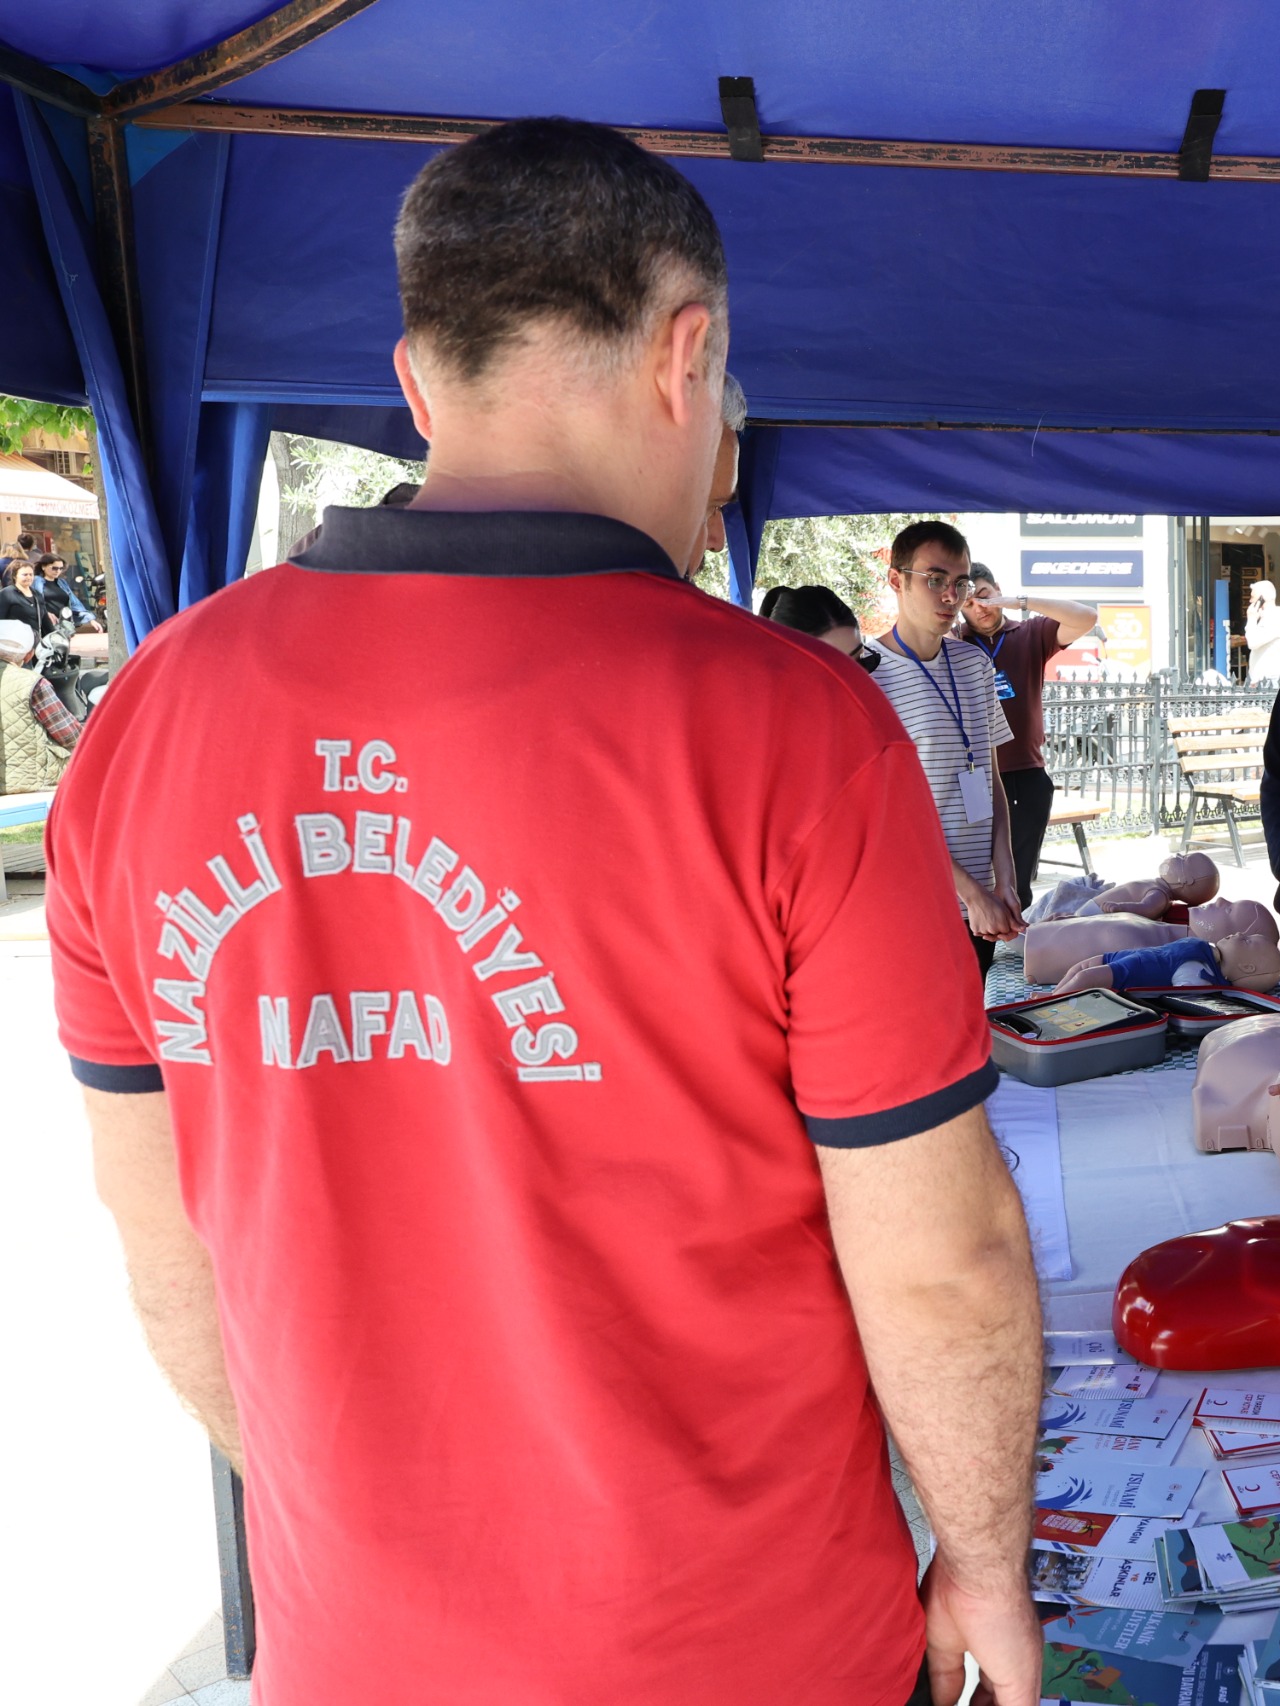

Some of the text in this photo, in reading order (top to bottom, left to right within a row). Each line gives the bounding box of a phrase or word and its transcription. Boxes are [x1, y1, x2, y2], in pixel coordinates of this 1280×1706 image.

[1030, 562, 1134, 575] SKECHERS
[315, 739, 408, 794] T.C.
[153, 810, 602, 1082] NAZİLLİ BELEDİYESİ
[258, 990, 451, 1069] NAFAD
[1109, 1399, 1135, 1429] TSUNAMİ
[1118, 1472, 1145, 1509] TSUNAMİ
[1142, 1571, 1157, 1586] SEL
[1218, 1685, 1229, 1703] AFAD
